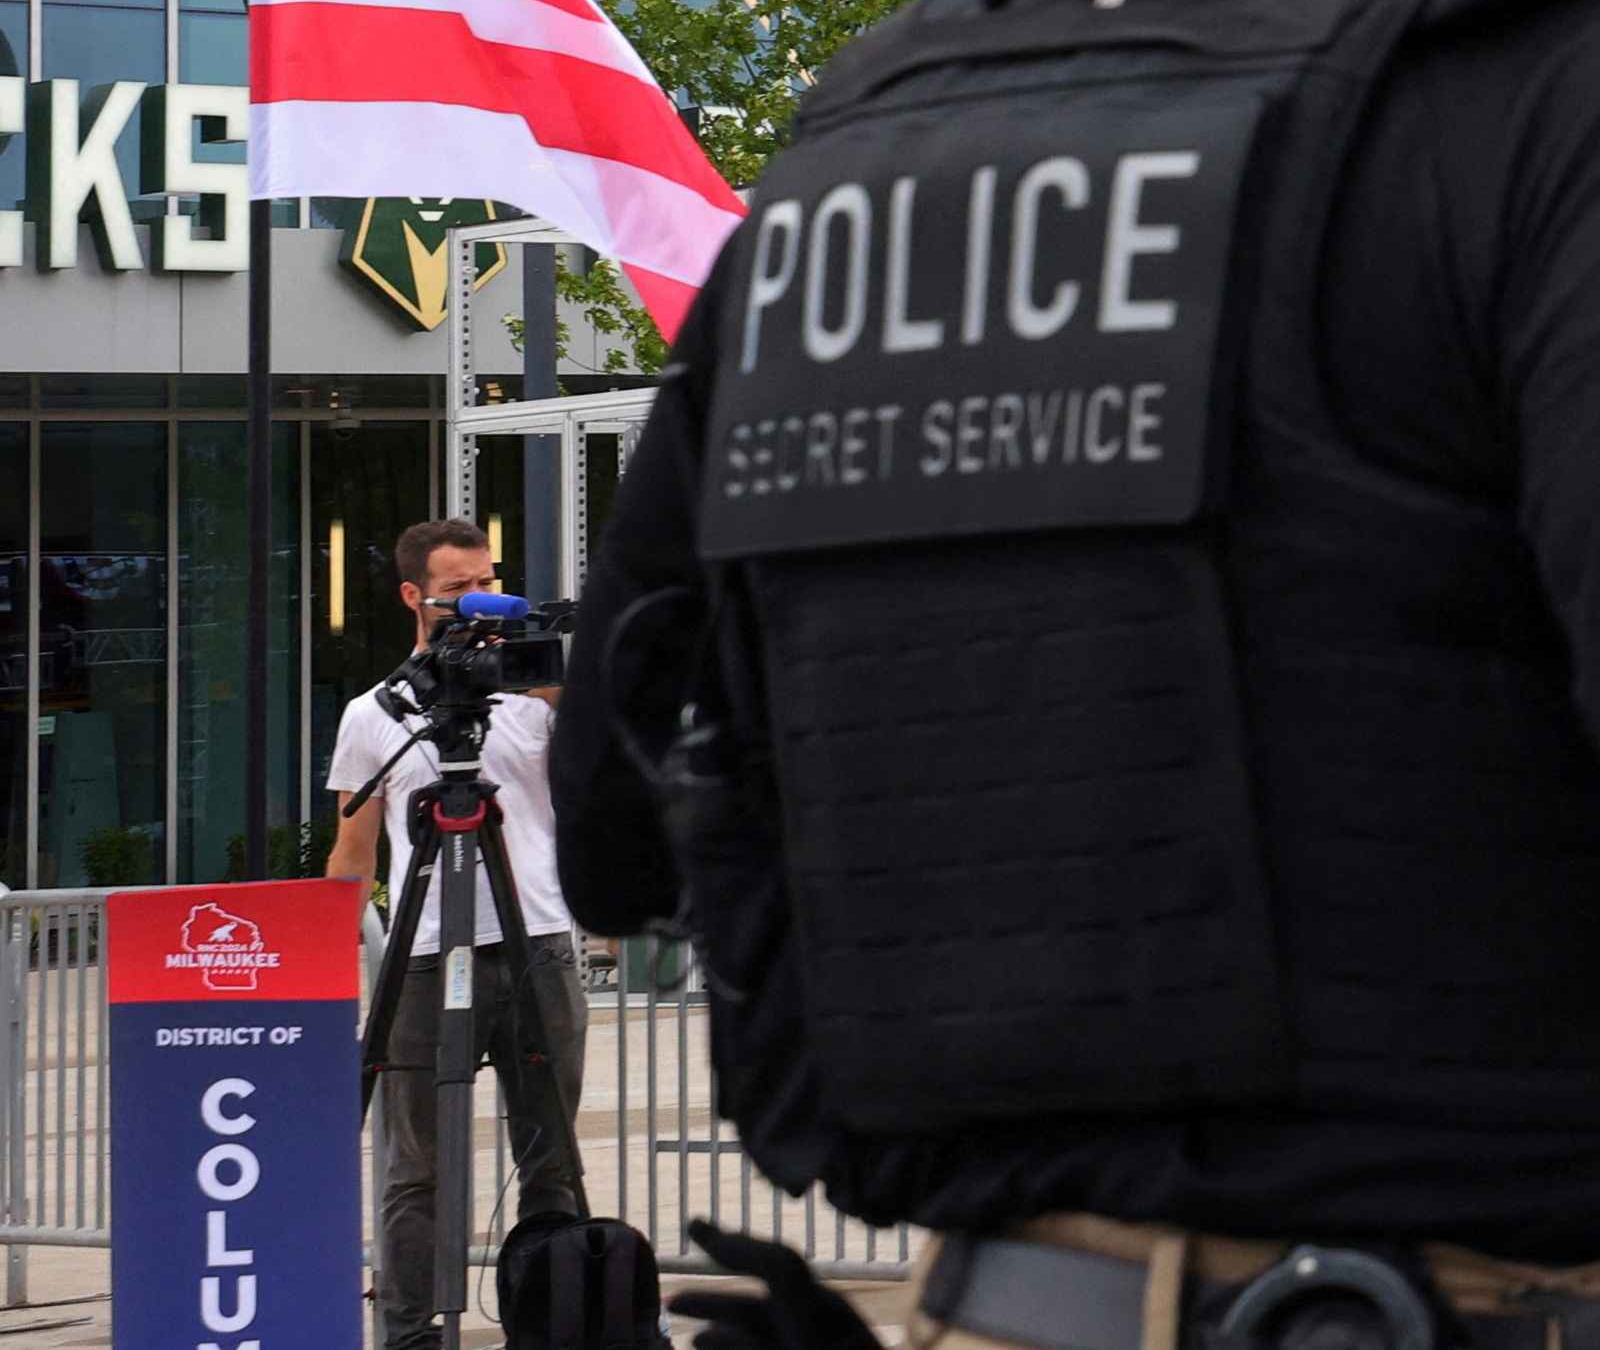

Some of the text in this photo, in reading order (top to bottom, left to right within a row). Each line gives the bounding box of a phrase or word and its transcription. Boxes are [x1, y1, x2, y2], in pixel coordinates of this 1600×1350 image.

[741, 150, 1201, 374] POLICE
[723, 382, 1167, 497] SECRET SERVICE
[165, 953, 280, 967] MILWAUKEE
[156, 1027, 302, 1046] DISTRICT OF
[198, 1078, 260, 1350] COLU
